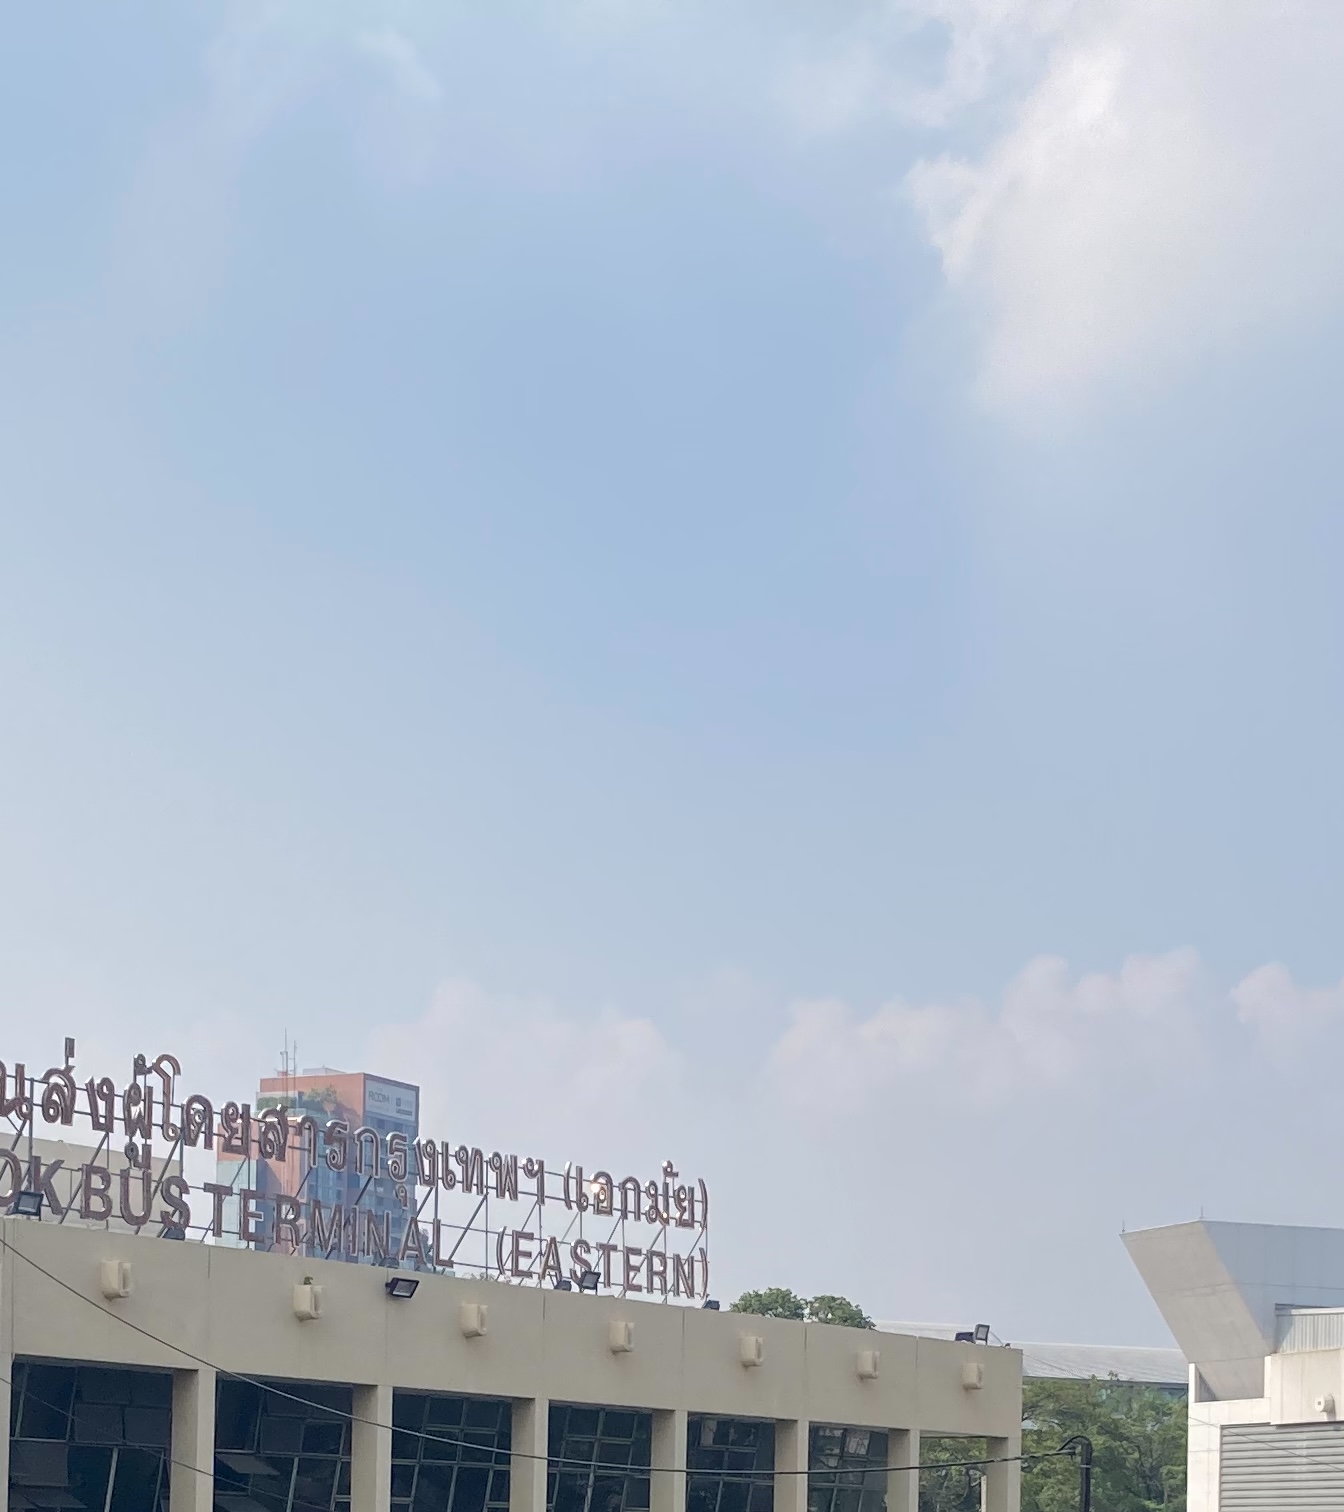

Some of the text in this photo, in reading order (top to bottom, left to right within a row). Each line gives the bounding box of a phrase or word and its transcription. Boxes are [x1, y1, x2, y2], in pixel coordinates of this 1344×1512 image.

[79, 1163, 192, 1232] BUS
[203, 1182, 455, 1268] TERMINAL
[496, 1225, 710, 1301] (EASTERN)
[563, 1159, 709, 1230] (เอกมัย)
